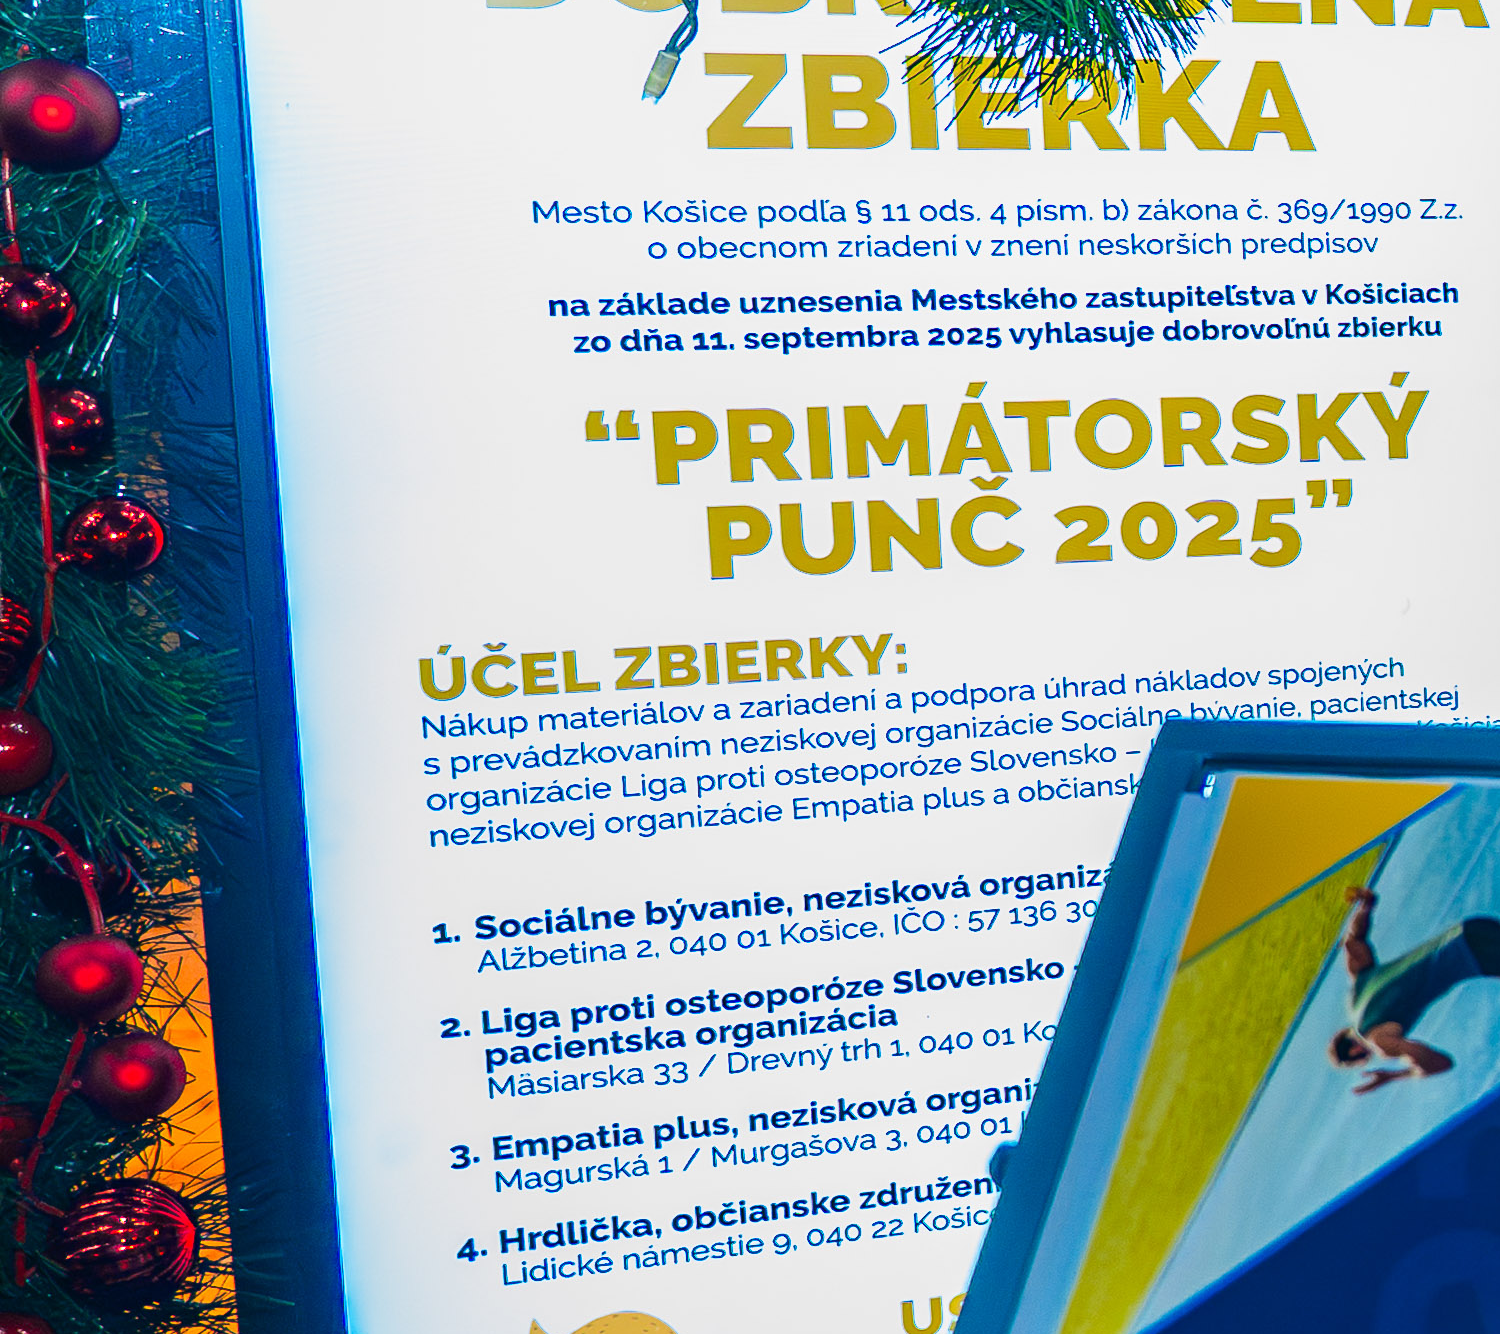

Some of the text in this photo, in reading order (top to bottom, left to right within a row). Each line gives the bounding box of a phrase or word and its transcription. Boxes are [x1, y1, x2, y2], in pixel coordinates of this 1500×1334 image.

[703, 52, 1317, 152] ZBIERKA
[531, 198, 1464, 230] Mesto Košice podľa § 11 ods. 4 písm. b) zákona č. 369/1990 Z.z.
[647, 231, 1379, 261] o obecnom zriadení v znení neskorších predpisov
[548, 281, 1460, 317] na základe uznesenia Mestského zastupiteľstva v Košiciach
[573, 315, 1443, 356] zo dňa 11. septembra 2025 vyhlasuje dobrovoľnú zbierku
[705, 477, 1023, 581] PUNČ
[418, 632, 908, 702] ÚČEL ZBIERKY:
[421, 656, 1405, 740] Nákup materiálov a zariadení a podpora úhrad nákladov spojených
[423, 757, 441, 776] s
[450, 739, 712, 780] prevádzkovaním
[720, 727, 877, 756] neziskovej
[885, 717, 1054, 749] organizácie
[1060, 706, 1182, 732] Sociálne
[1309, 685, 1460, 725] pacientskej
[426, 742, 1117, 816] organizácie Liga proti osteoporóze Slovensko
[429, 817, 596, 848] neziskovej
[604, 804, 783, 838] organizácie
[792, 791, 915, 823] Empatia
[923, 786, 986, 817] plus
[992, 787, 1010, 805] a
[431, 922, 461, 945] 1.
[474, 905, 636, 941] Sociálne
[644, 891, 794, 931] bývanie,
[803, 874, 972, 913] nezisková
[477, 940, 628, 974] Alžbetina
[636, 939, 660, 960] 2,
[669, 932, 727, 957] 040
[736, 929, 772, 950] 01
[779, 919, 885, 946] Košice,
[893, 906, 946, 936] IČO
[968, 908, 1001, 933] 57
[1008, 899, 1058, 928] 136
[439, 957, 1065, 1039] 2. Liga proti osteoporóze Slovensko
[484, 1003, 899, 1075] pacientska organizácia
[487, 1064, 645, 1100] Mäsiarska
[653, 1061, 689, 1086] 33
[727, 1047, 834, 1075] Drevný
[840, 1037, 882, 1063] trh
[889, 1039, 910, 1058] 1,
[918, 1031, 974, 1055] 040
[982, 1027, 1016, 1048] 01
[449, 1077, 1039, 1170] 3. Empatia plus, nezisková organi
[494, 1156, 650, 1194] Magurská
[658, 1155, 674, 1174] 1
[711, 1133, 878, 1168] Murgašova
[885, 1129, 909, 1152] 3,
[916, 1120, 972, 1145] 040
[980, 1116, 1014, 1137] 01
[456, 1175, 1001, 1263] 4. Hrdlička, občianske združen
[501, 1250, 614, 1287] Lidické
[622, 1235, 765, 1271] námestie
[771, 1233, 798, 1256] 9,
[806, 1223, 862, 1248] 040
[871, 1218, 905, 1240] 22
